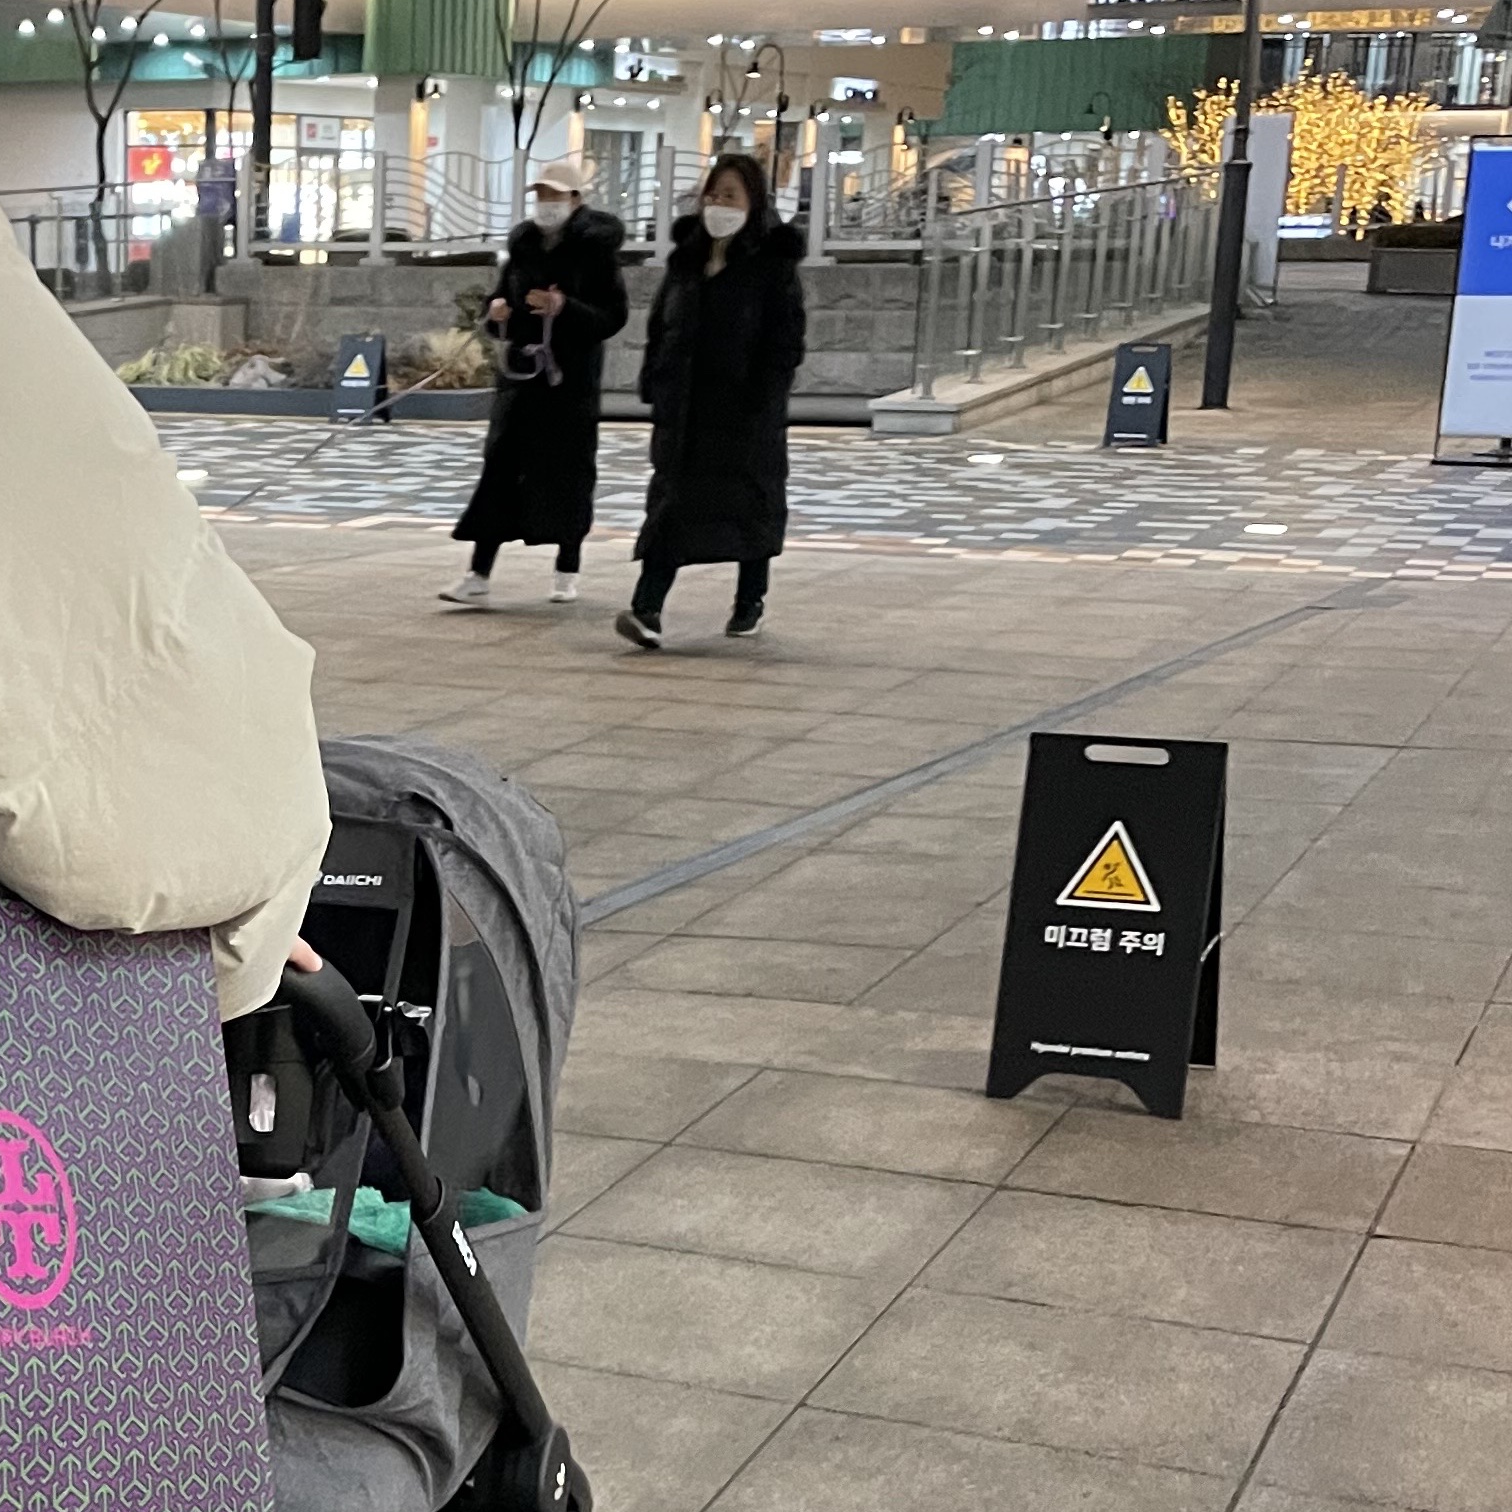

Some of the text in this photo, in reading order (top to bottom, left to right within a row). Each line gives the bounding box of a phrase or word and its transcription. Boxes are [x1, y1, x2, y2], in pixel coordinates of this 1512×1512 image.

[323, 874, 383, 886] DAIICHI
[1044, 925, 1166, 957] 미끄럼 주의
